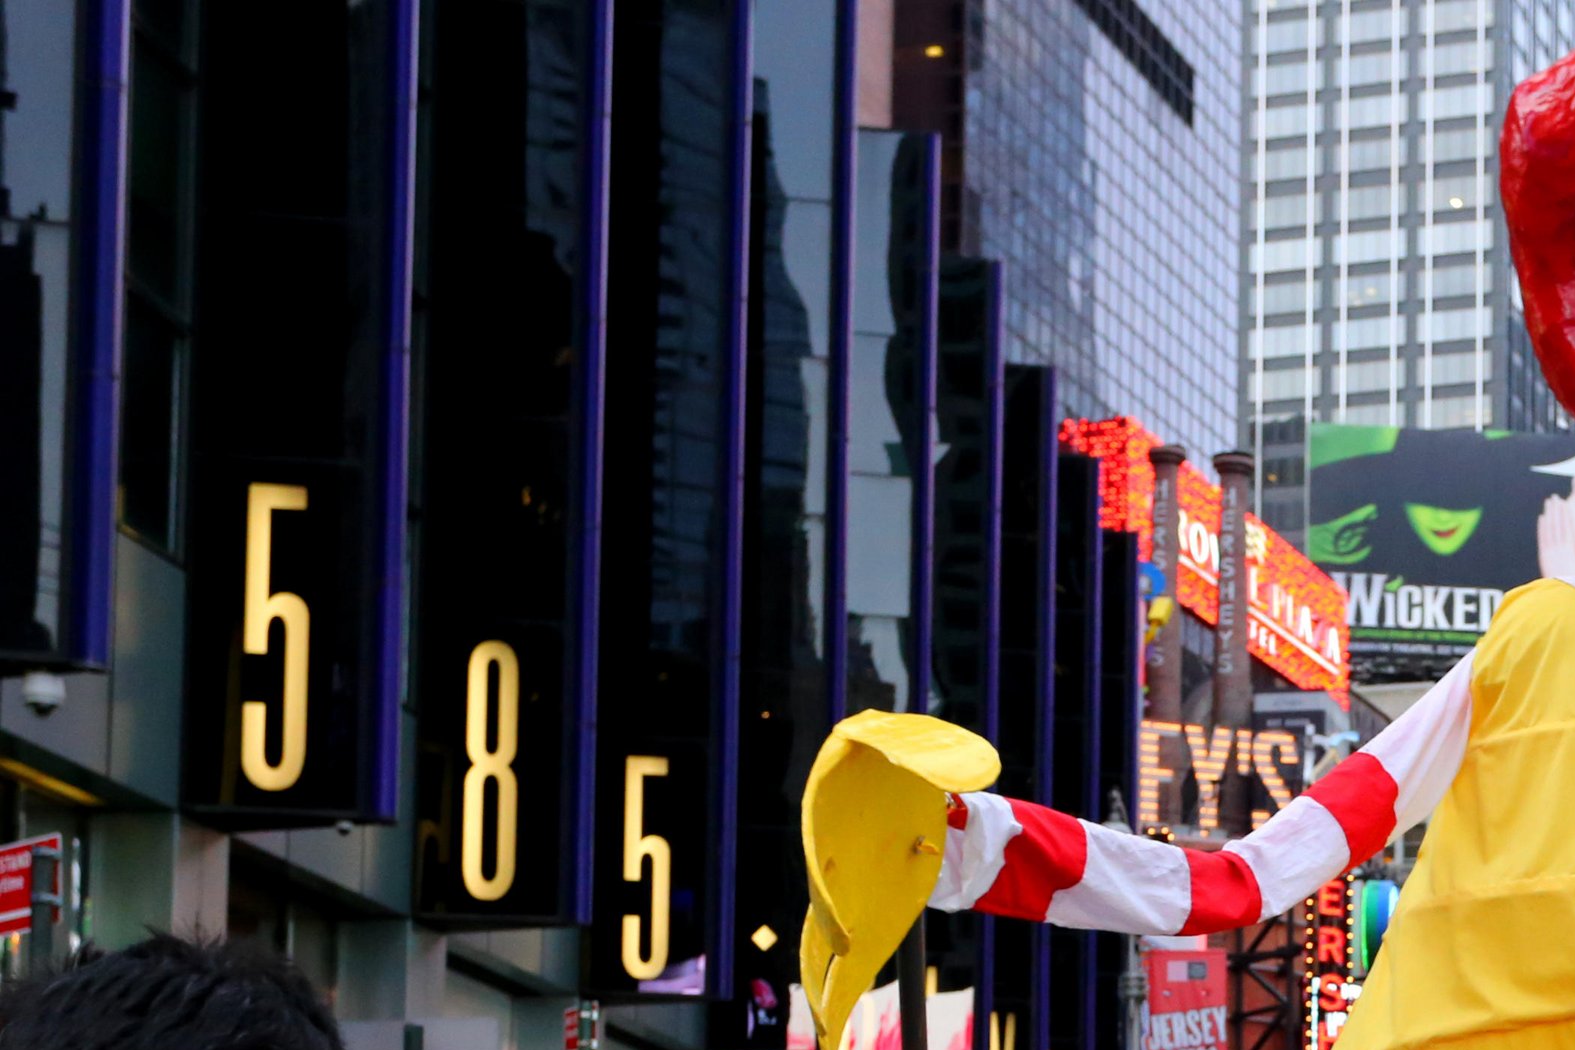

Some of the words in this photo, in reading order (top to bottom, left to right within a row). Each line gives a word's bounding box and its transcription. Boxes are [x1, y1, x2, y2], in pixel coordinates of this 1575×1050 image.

[241, 482, 310, 791] 5
[462, 640, 519, 901] 8
[622, 755, 671, 981] 5
